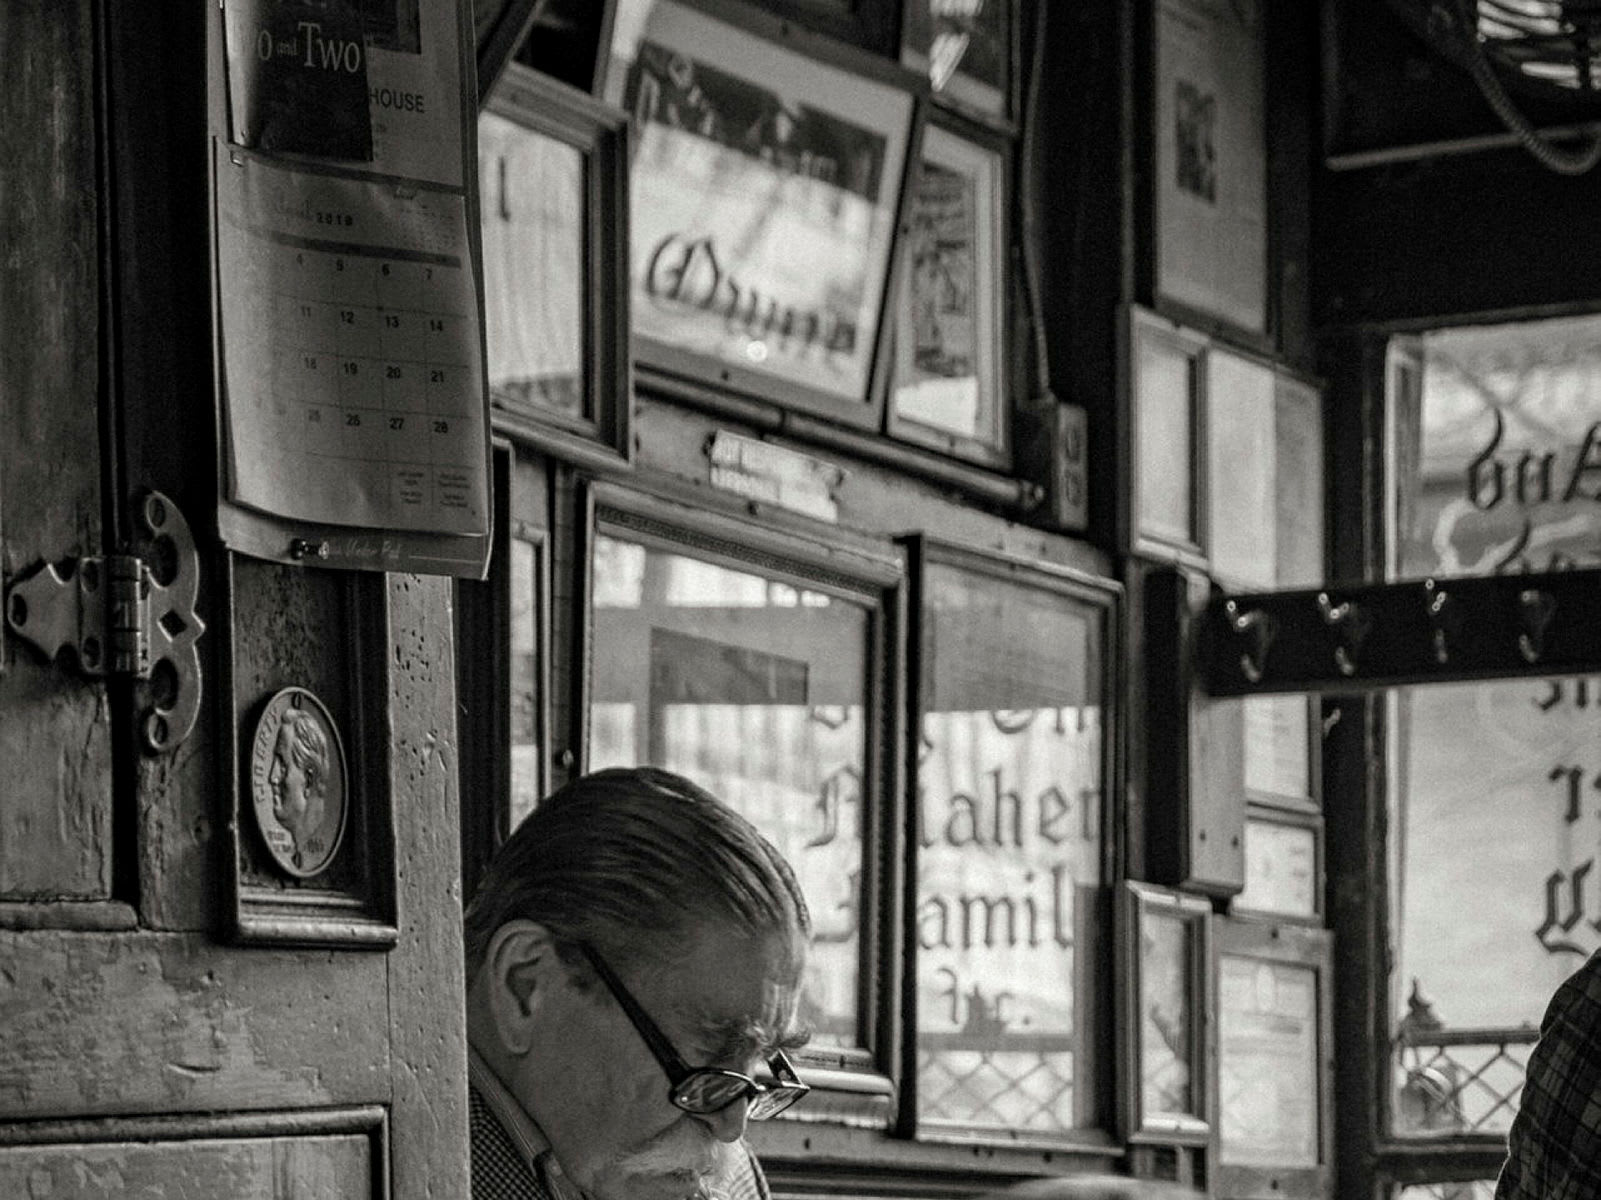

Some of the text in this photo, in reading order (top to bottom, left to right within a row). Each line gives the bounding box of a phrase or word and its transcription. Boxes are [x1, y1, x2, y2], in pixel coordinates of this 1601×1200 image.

[369, 87, 426, 114] HOUSE
[381, 264, 391, 277] 6
[425, 268, 433, 281] 7
[340, 311, 355, 325] 12
[386, 316, 400, 329] 13
[430, 320, 445, 332] 14
[343, 362, 358, 376] 19
[386, 366, 403, 380] 20
[430, 370, 445, 383] 21
[346, 413, 362, 427] 26
[389, 416, 405, 431] 27
[433, 420, 450, 434] 28
